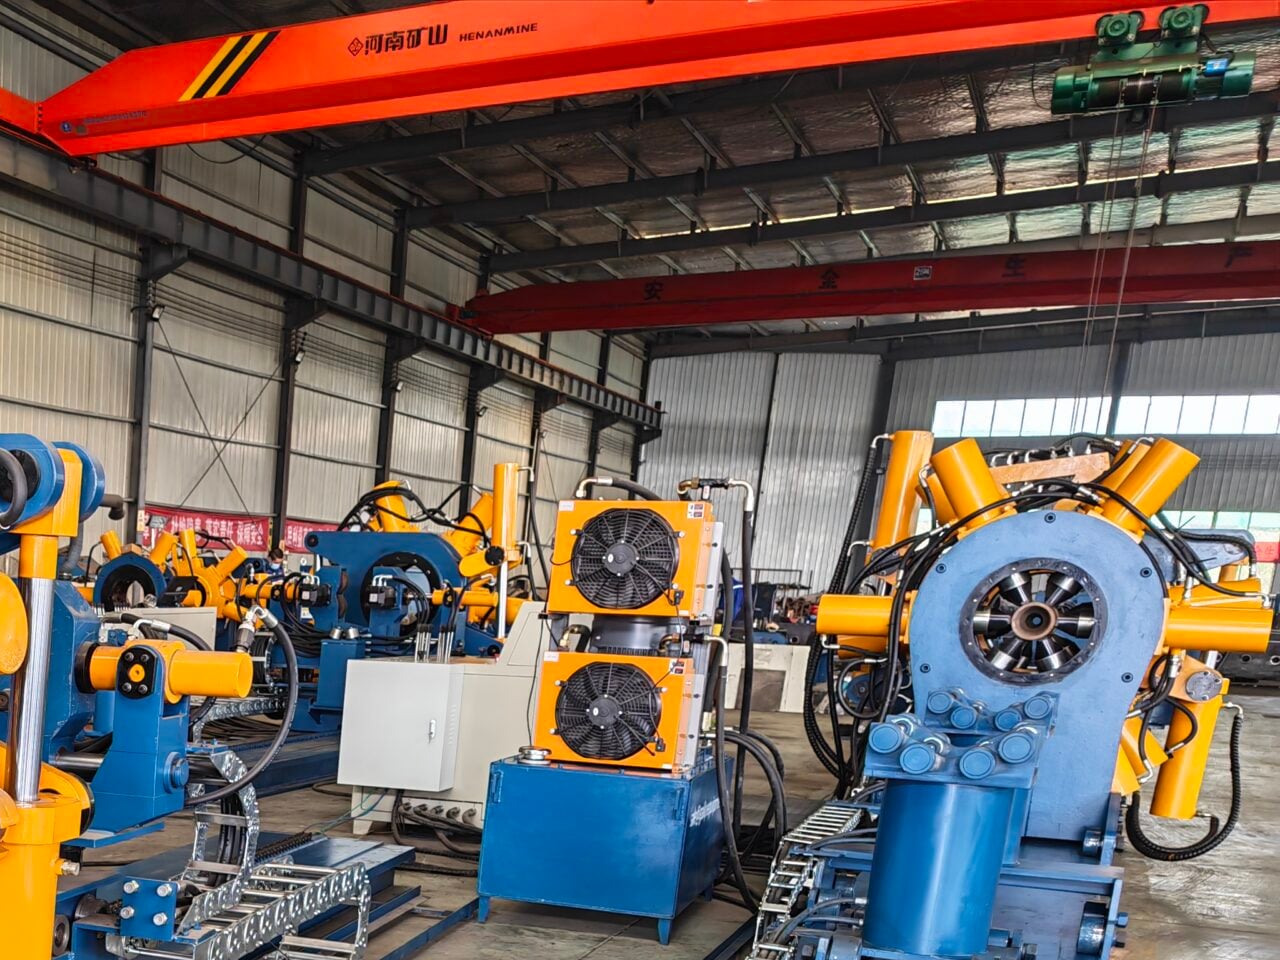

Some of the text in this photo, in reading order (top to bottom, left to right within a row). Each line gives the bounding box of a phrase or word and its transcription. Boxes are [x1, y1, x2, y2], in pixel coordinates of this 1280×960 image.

[365, 24, 448, 55] 河南矿山
[459, 23, 538, 42] HENANMINE
[237, 520, 263, 545] 保障安全
